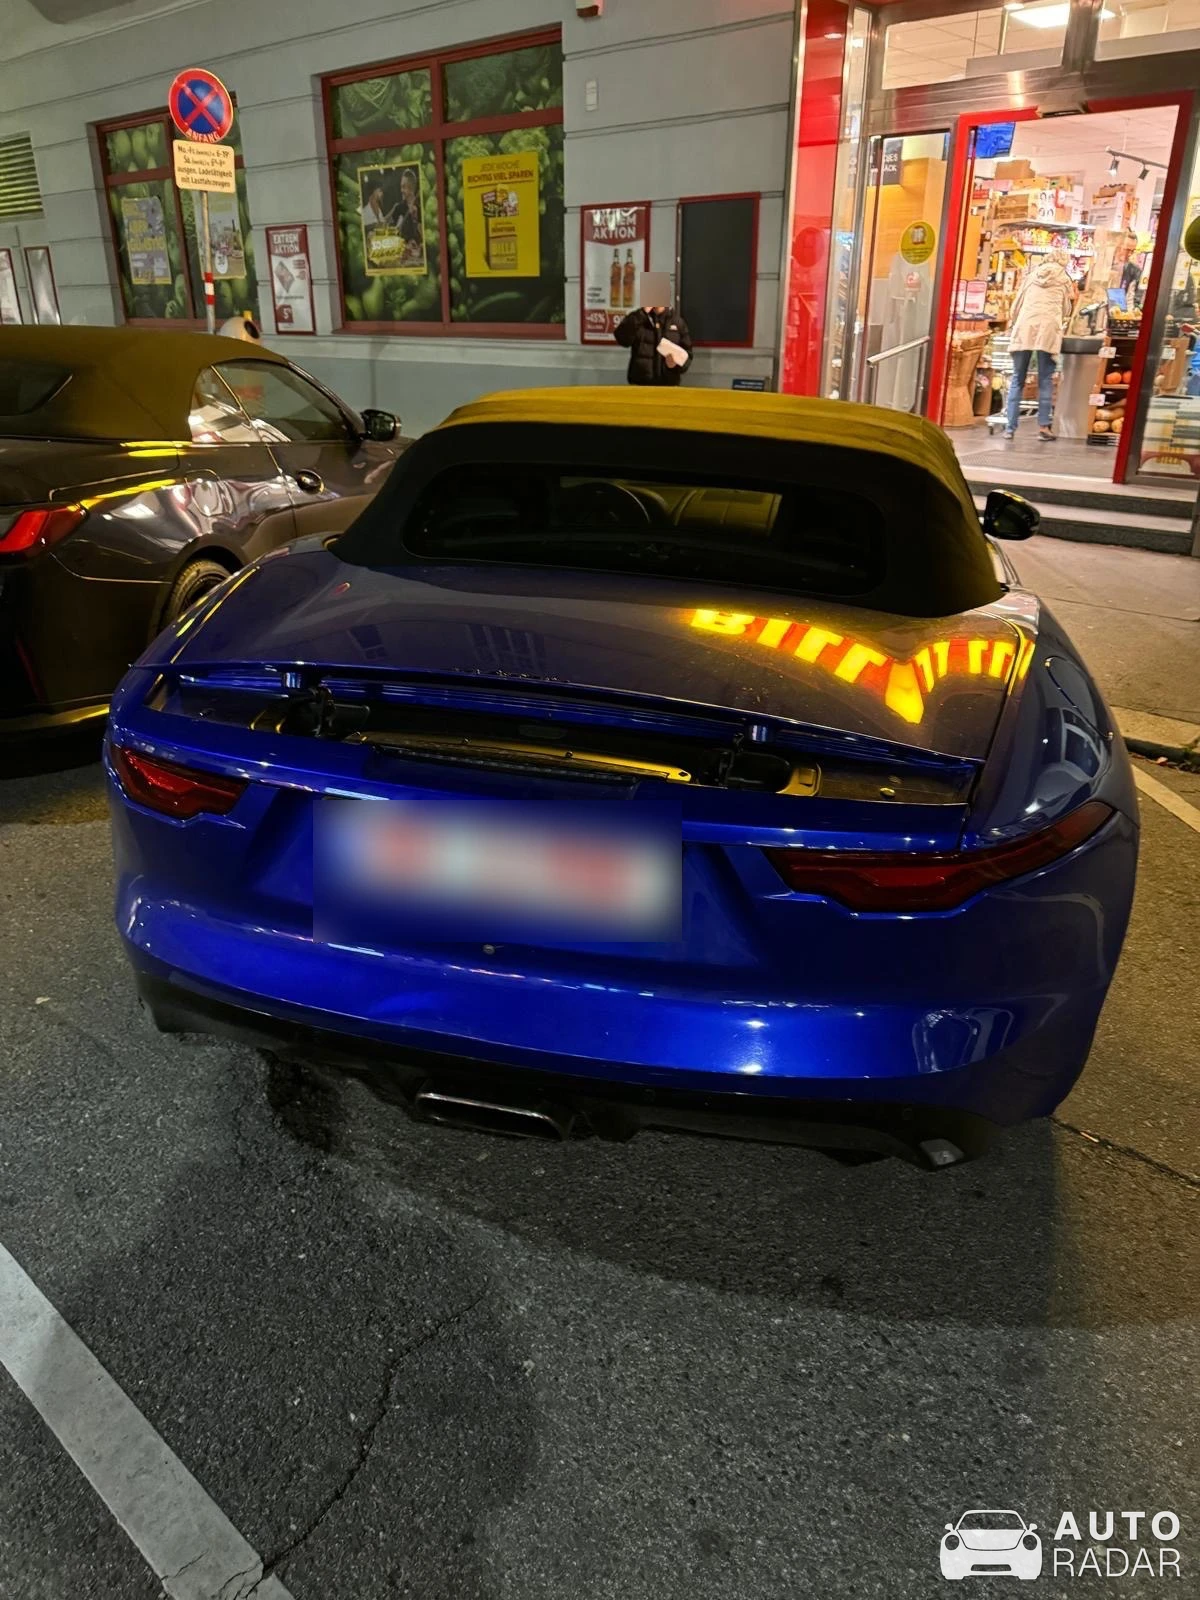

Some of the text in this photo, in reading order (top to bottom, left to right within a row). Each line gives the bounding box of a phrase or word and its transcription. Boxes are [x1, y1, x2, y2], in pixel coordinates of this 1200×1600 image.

[185, 128, 221, 143] ANFANG
[191, 177, 231, 188] Lastfahrzeugen
[593, 226, 637, 239] AKTION
[274, 244, 300, 254] AKTION
